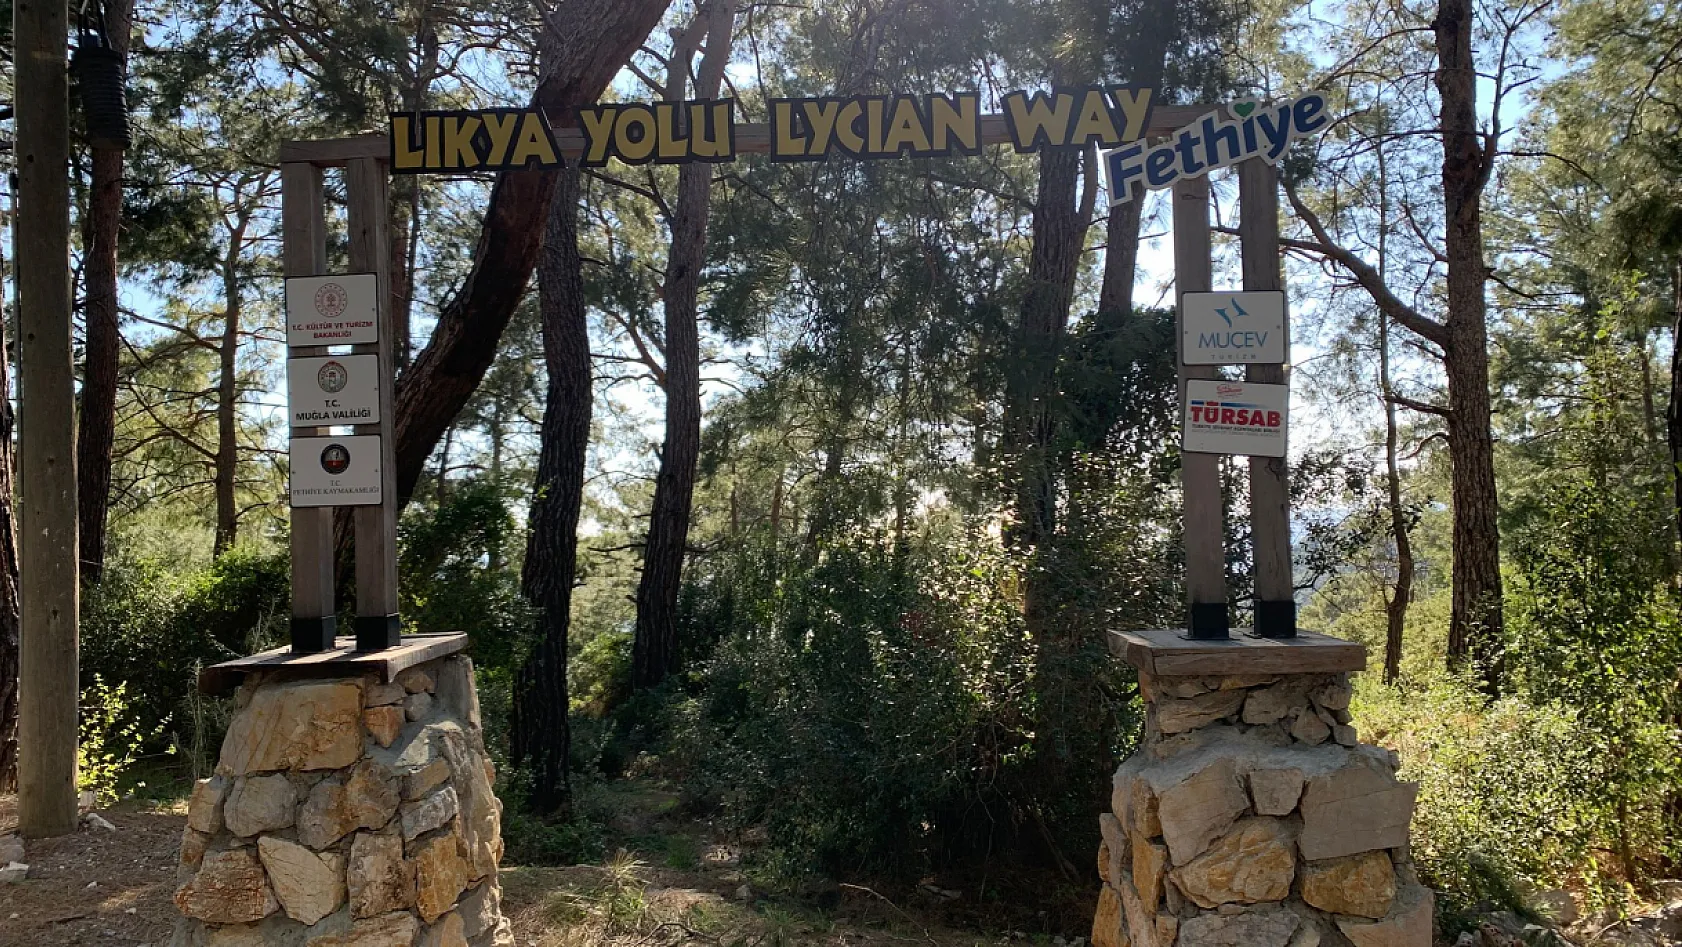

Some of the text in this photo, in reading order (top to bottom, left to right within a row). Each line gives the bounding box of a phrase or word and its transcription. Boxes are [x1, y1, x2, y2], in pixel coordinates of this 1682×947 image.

[393, 88, 1152, 168] LIKYA YOLU LYCIAN WAY
[1109, 94, 1327, 200] Fethiye
[306, 321, 333, 331] KÜLTÜR
[313, 331, 352, 339] BAKANLIĞI
[1198, 331, 1268, 349] MUÇEV
[324, 399, 341, 407] T.C.
[296, 407, 371, 421] MUĞLA VALİLİĞİ
[1190, 401, 1281, 427] TÜRSAB
